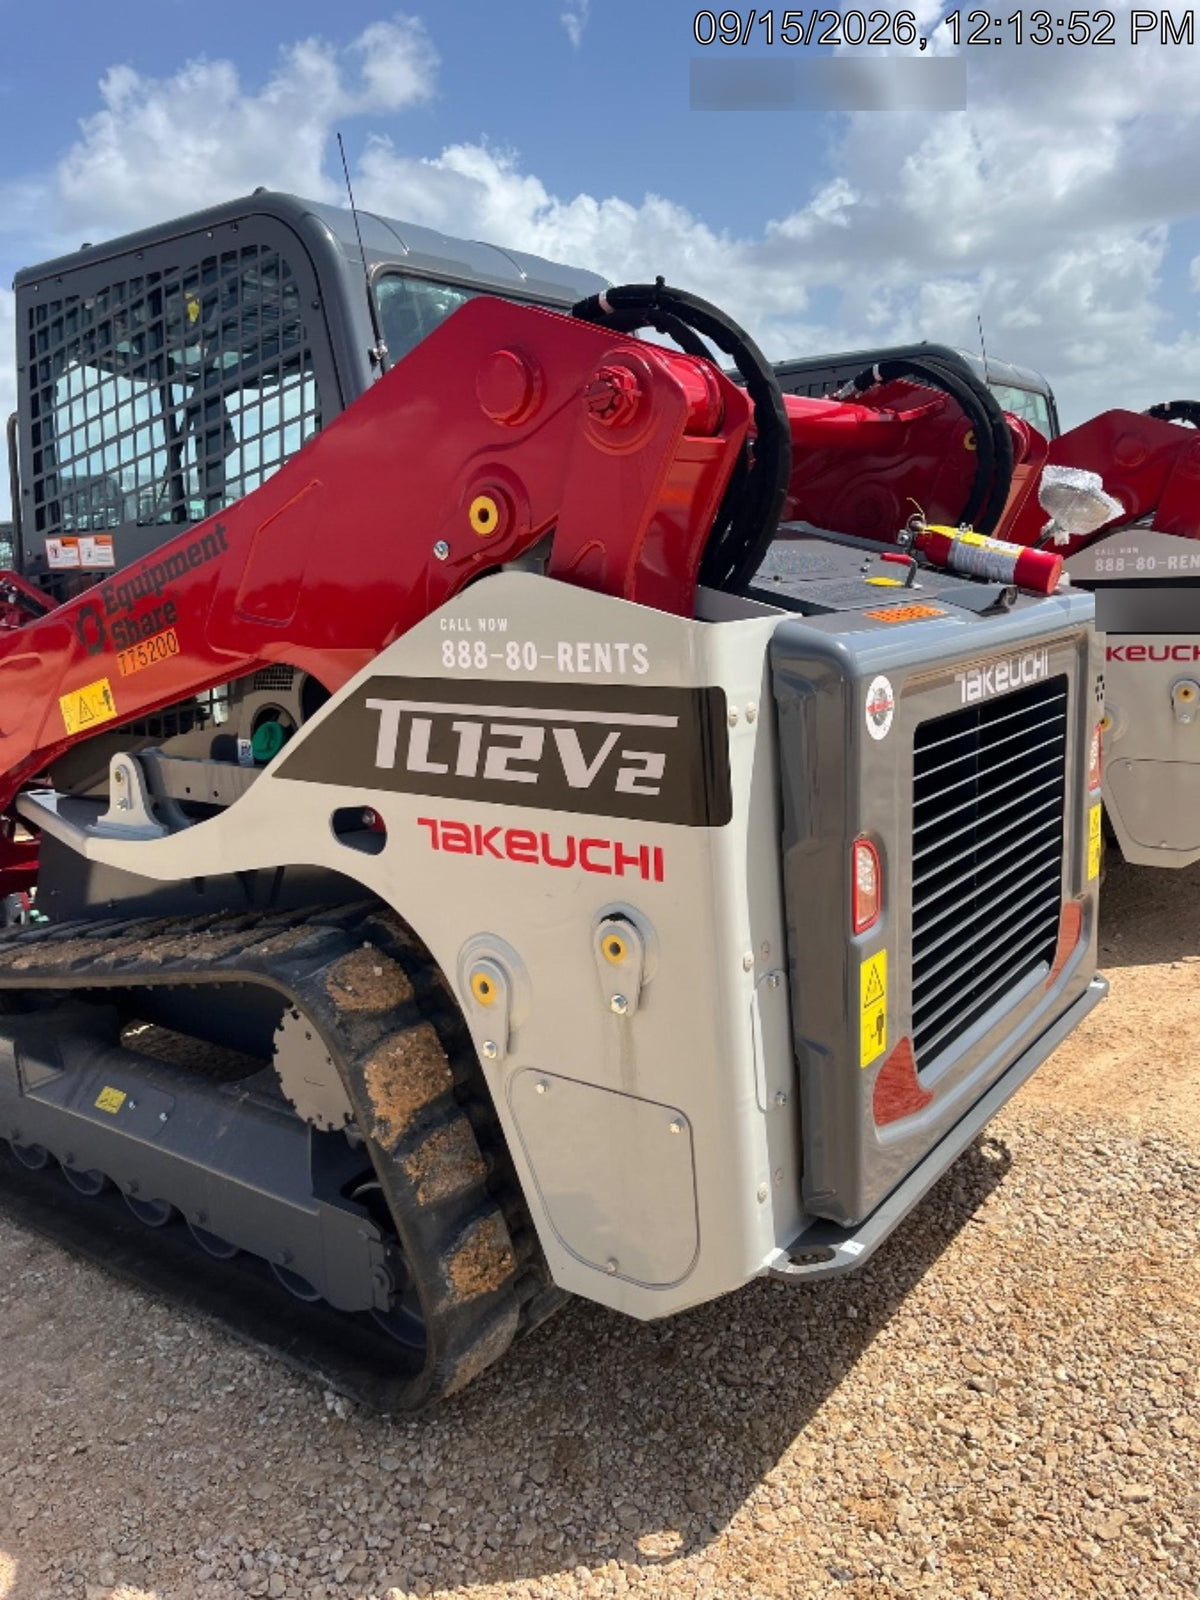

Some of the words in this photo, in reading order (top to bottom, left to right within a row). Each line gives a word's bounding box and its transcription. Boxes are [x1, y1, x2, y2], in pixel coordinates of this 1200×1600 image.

[101, 523, 228, 616] Equipment
[111, 602, 177, 650] Share
[440, 618, 471, 631] CALL
[478, 619, 508, 631] NOW
[118, 632, 177, 675] 775200
[442, 640, 649, 674] 888-80-RENTS
[366, 698, 679, 795] TL12V2
